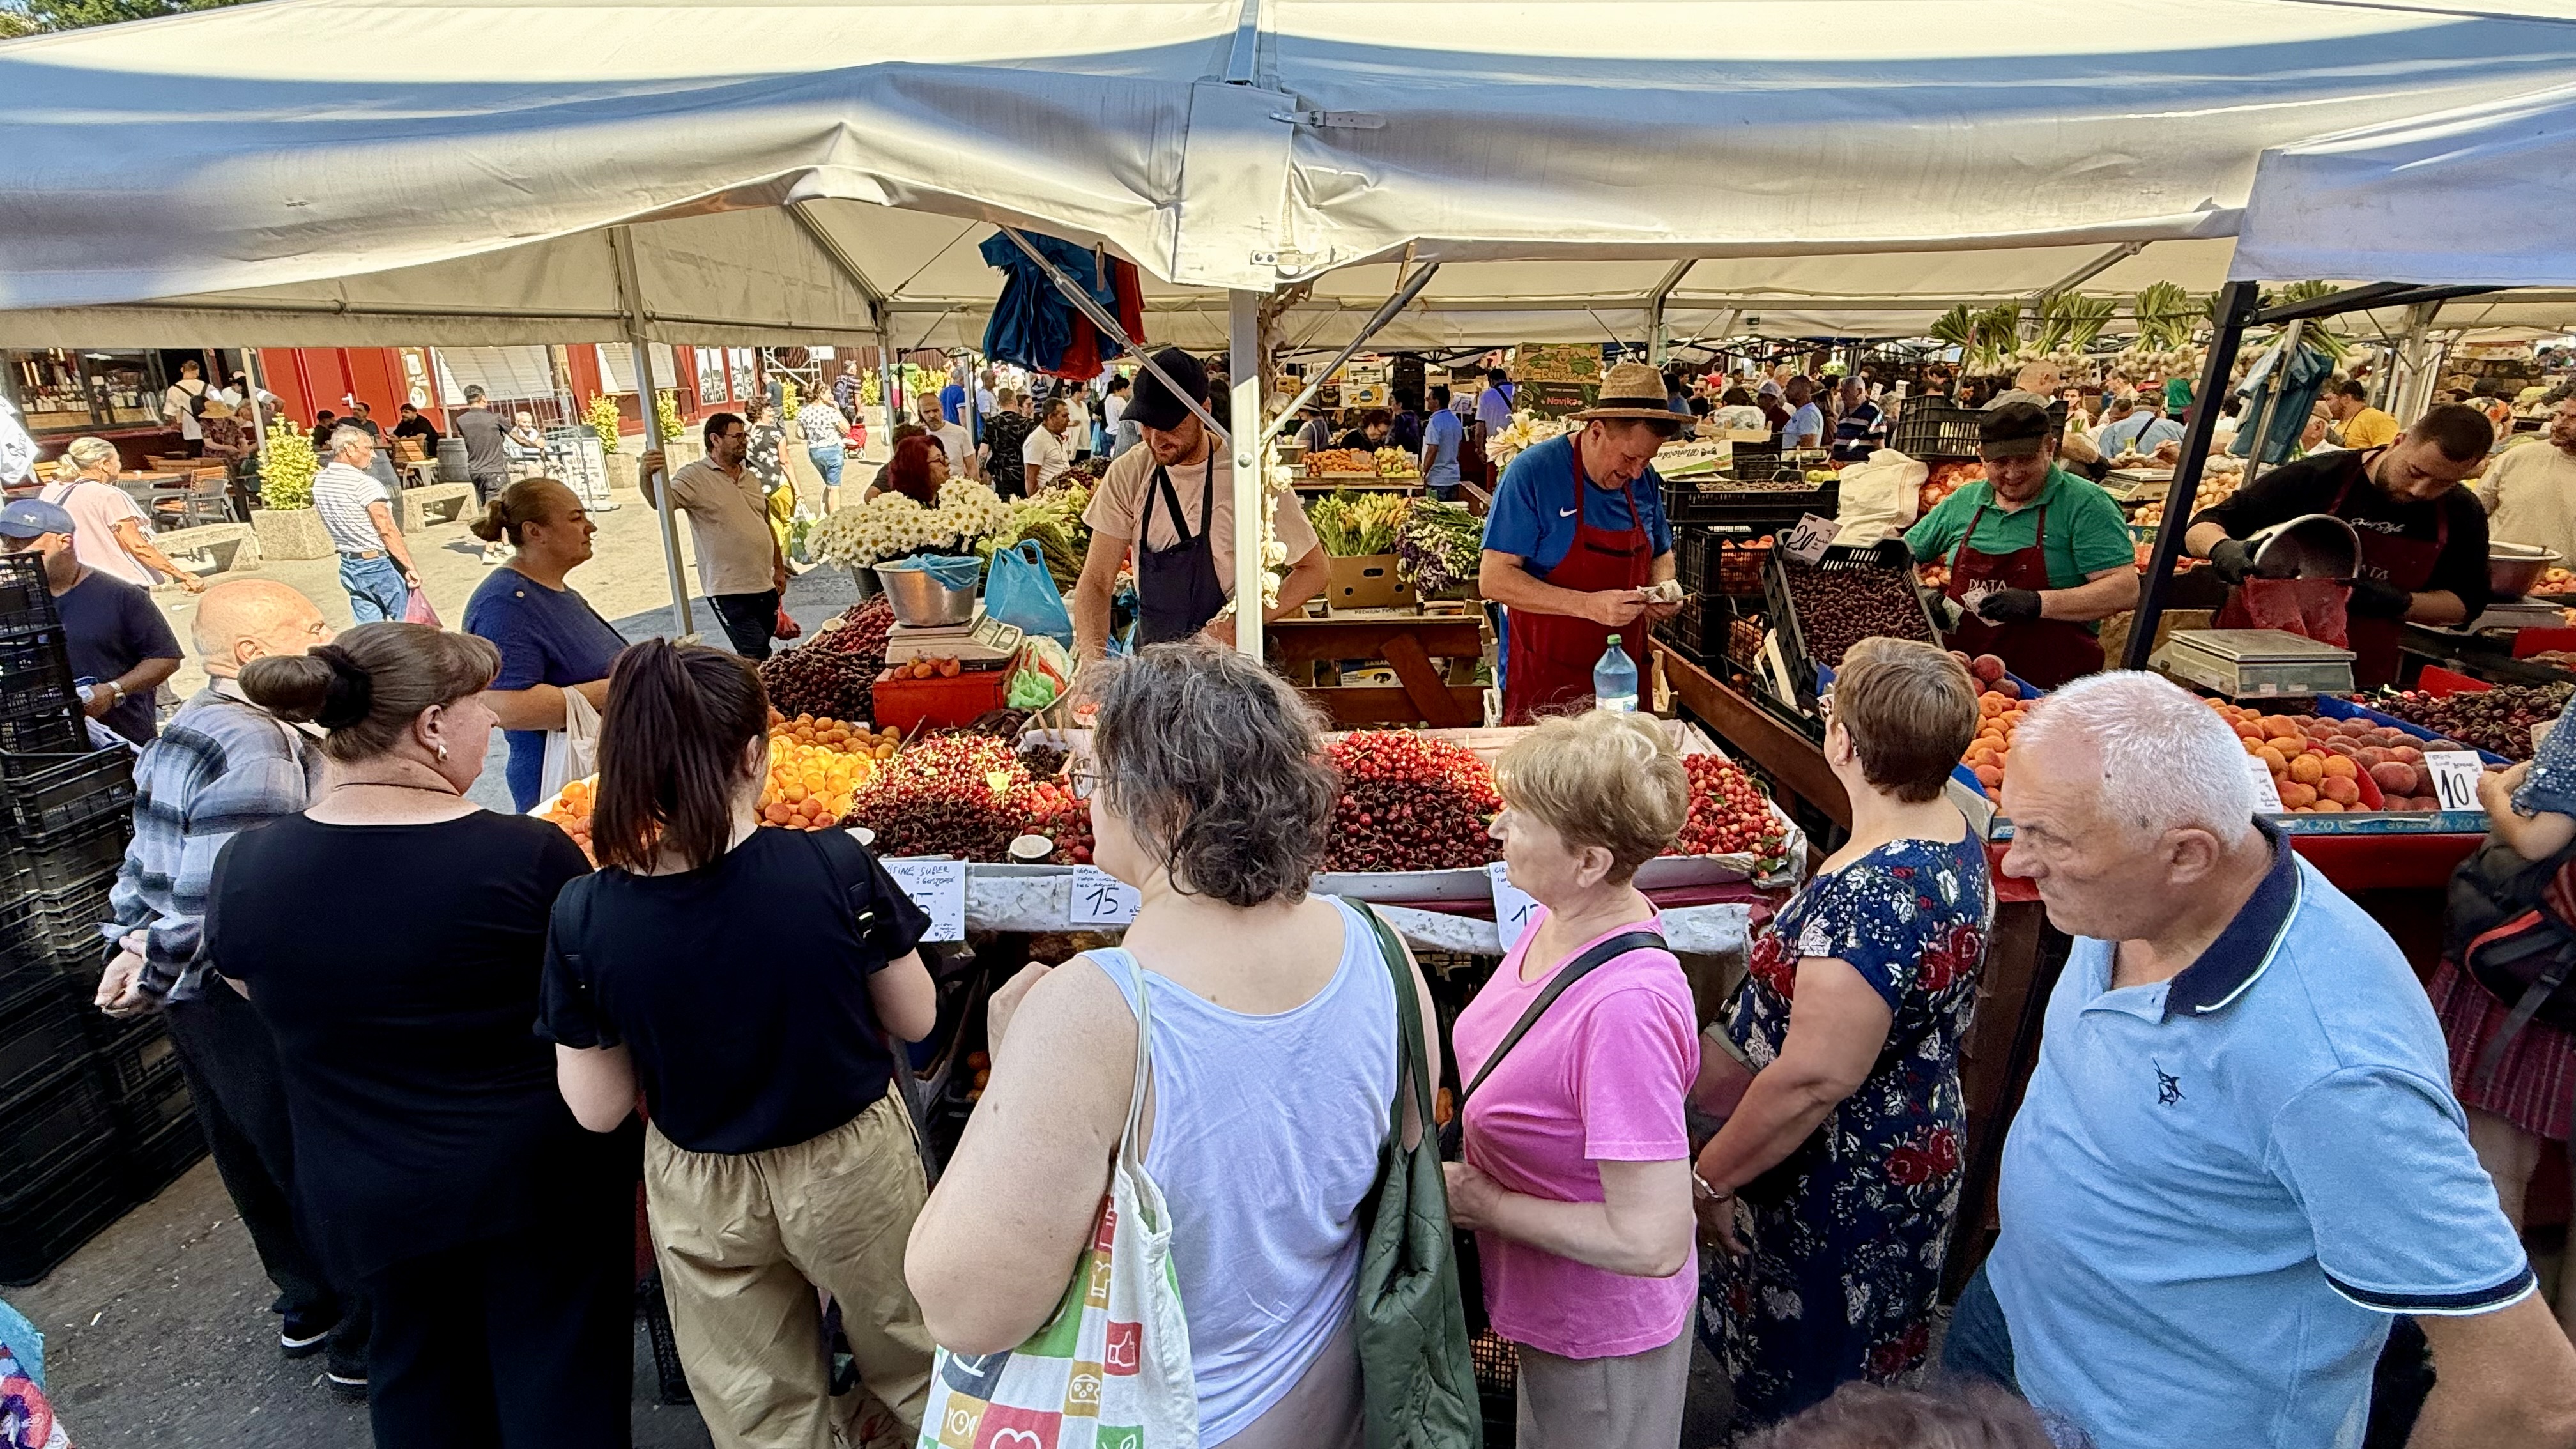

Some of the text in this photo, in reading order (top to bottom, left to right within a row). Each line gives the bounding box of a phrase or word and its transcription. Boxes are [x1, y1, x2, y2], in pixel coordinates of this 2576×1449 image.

[1786, 525, 1817, 551] 20
[2441, 769, 2470, 809] 10
[1086, 887, 1119, 916] 15
